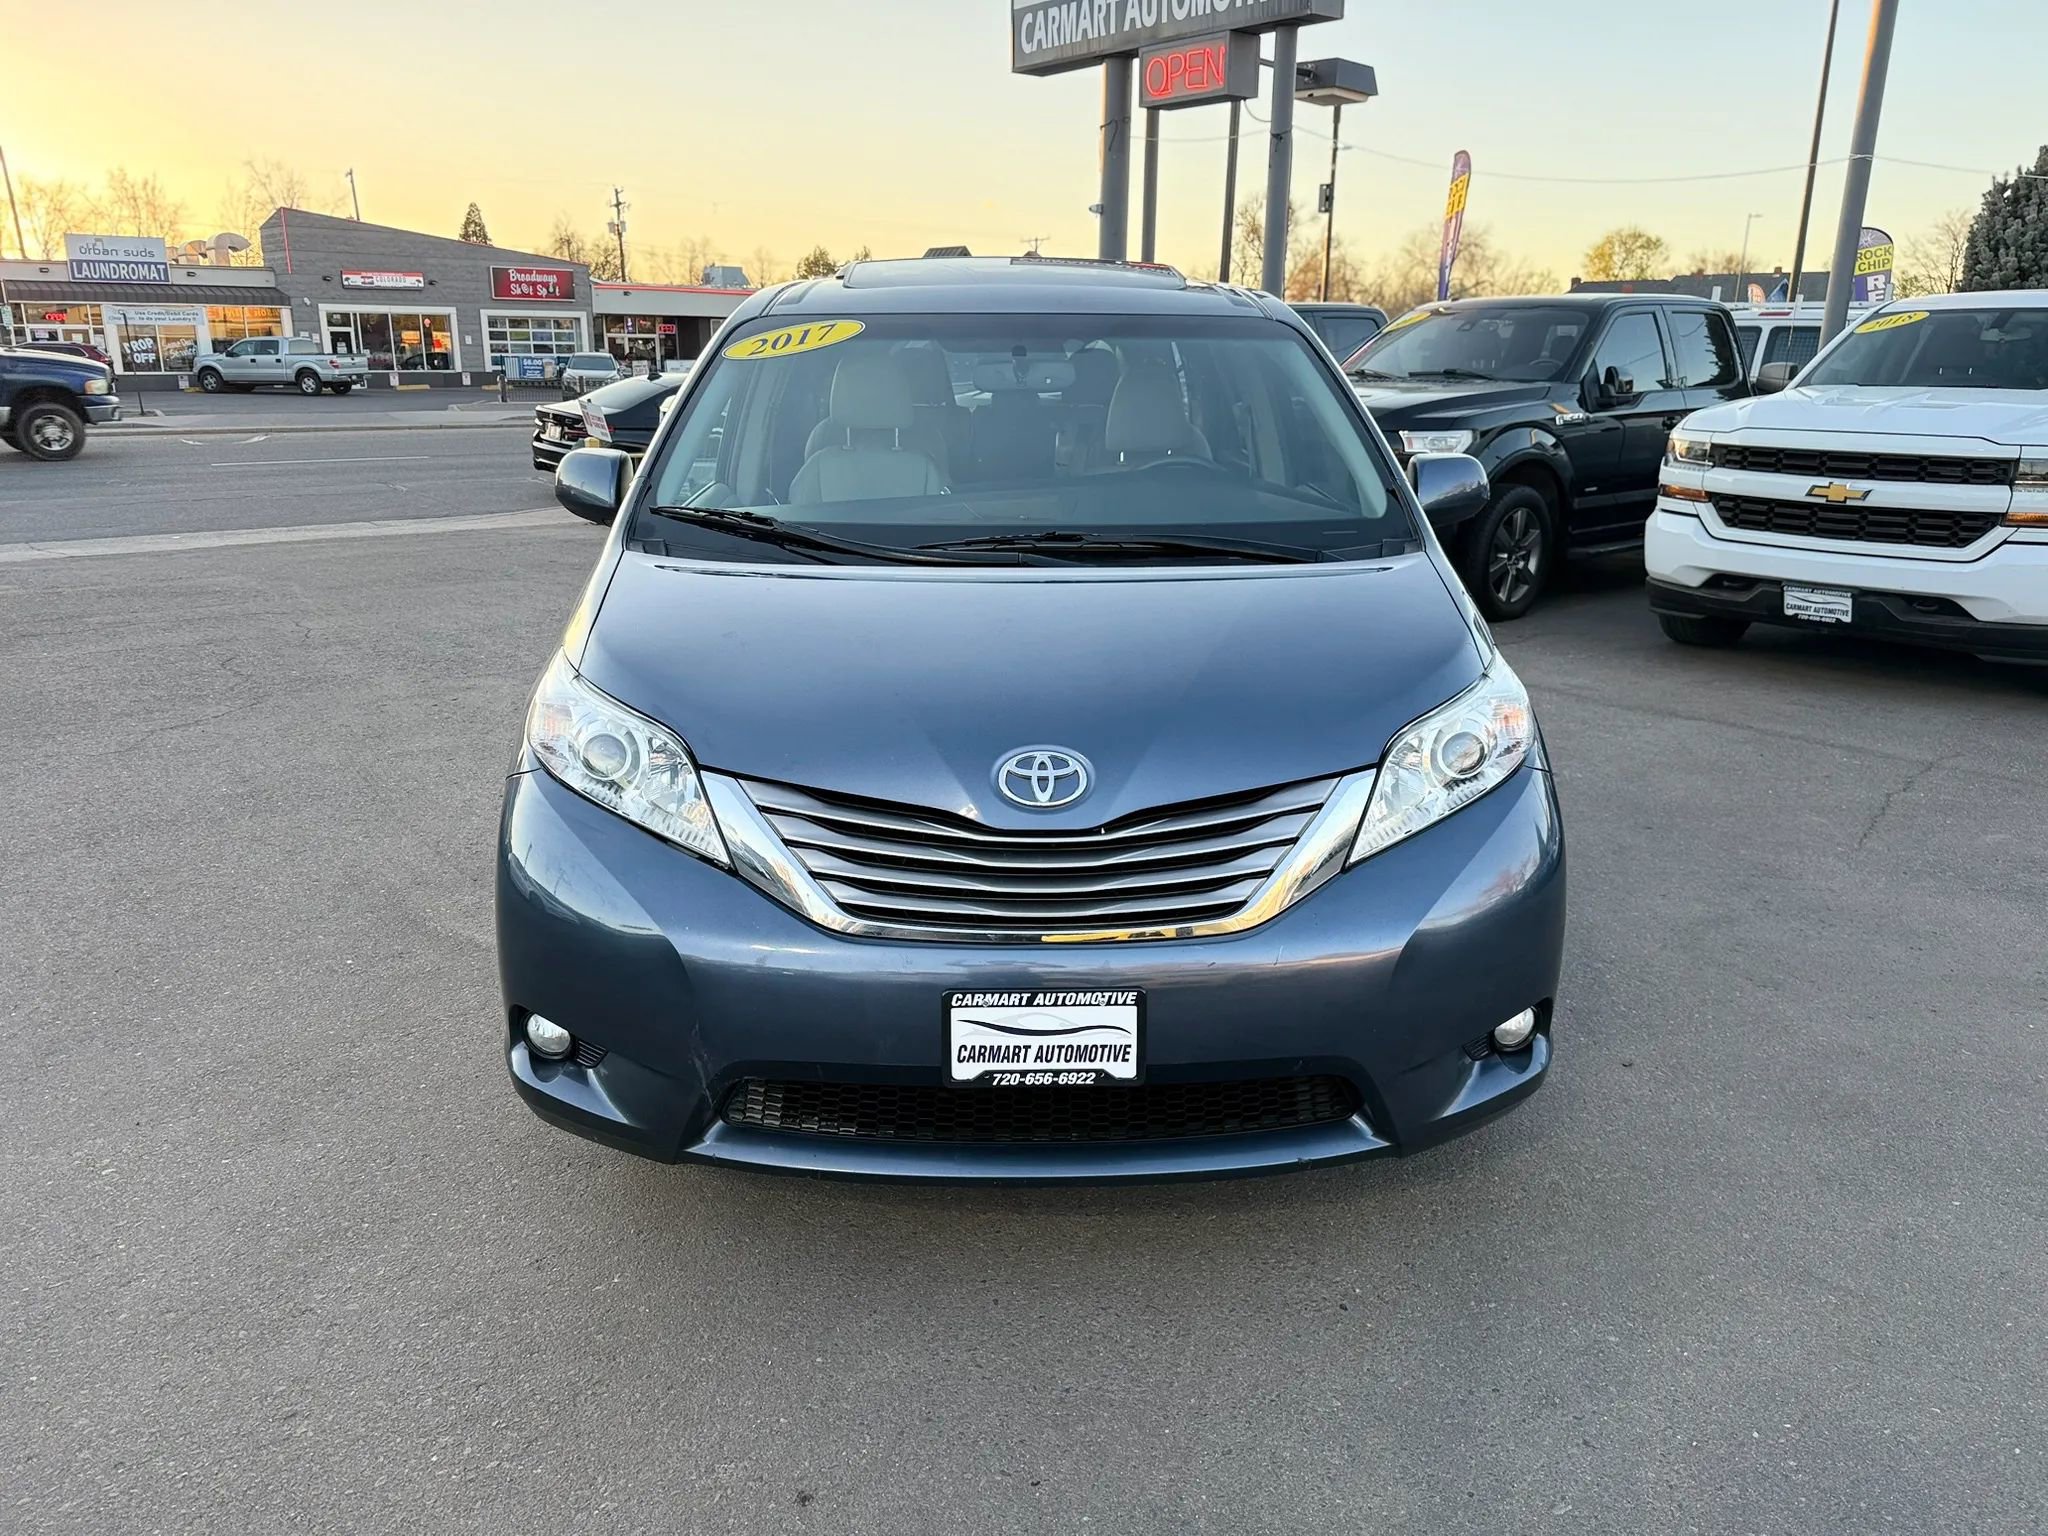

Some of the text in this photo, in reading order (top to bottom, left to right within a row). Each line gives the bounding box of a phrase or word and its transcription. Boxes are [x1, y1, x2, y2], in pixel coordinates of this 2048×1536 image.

[1020, 0, 1268, 54] CARMART AUTOM
[1145, 46, 1226, 97] OPEN
[123, 248, 156, 258] suds
[72, 261, 166, 281] LAUNDROMAT
[1858, 258, 1891, 272] CHIP
[747, 323, 838, 356] 2017
[133, 352, 156, 364] OFF
[1786, 602, 1850, 617] CARMART AUTOMOTIVE
[951, 992, 1138, 1007] CARMART AUTOMOTIVE
[957, 1044, 1132, 1064] CARMART AUTOMOTIVE
[992, 1072, 1096, 1086] 720-656-6922
